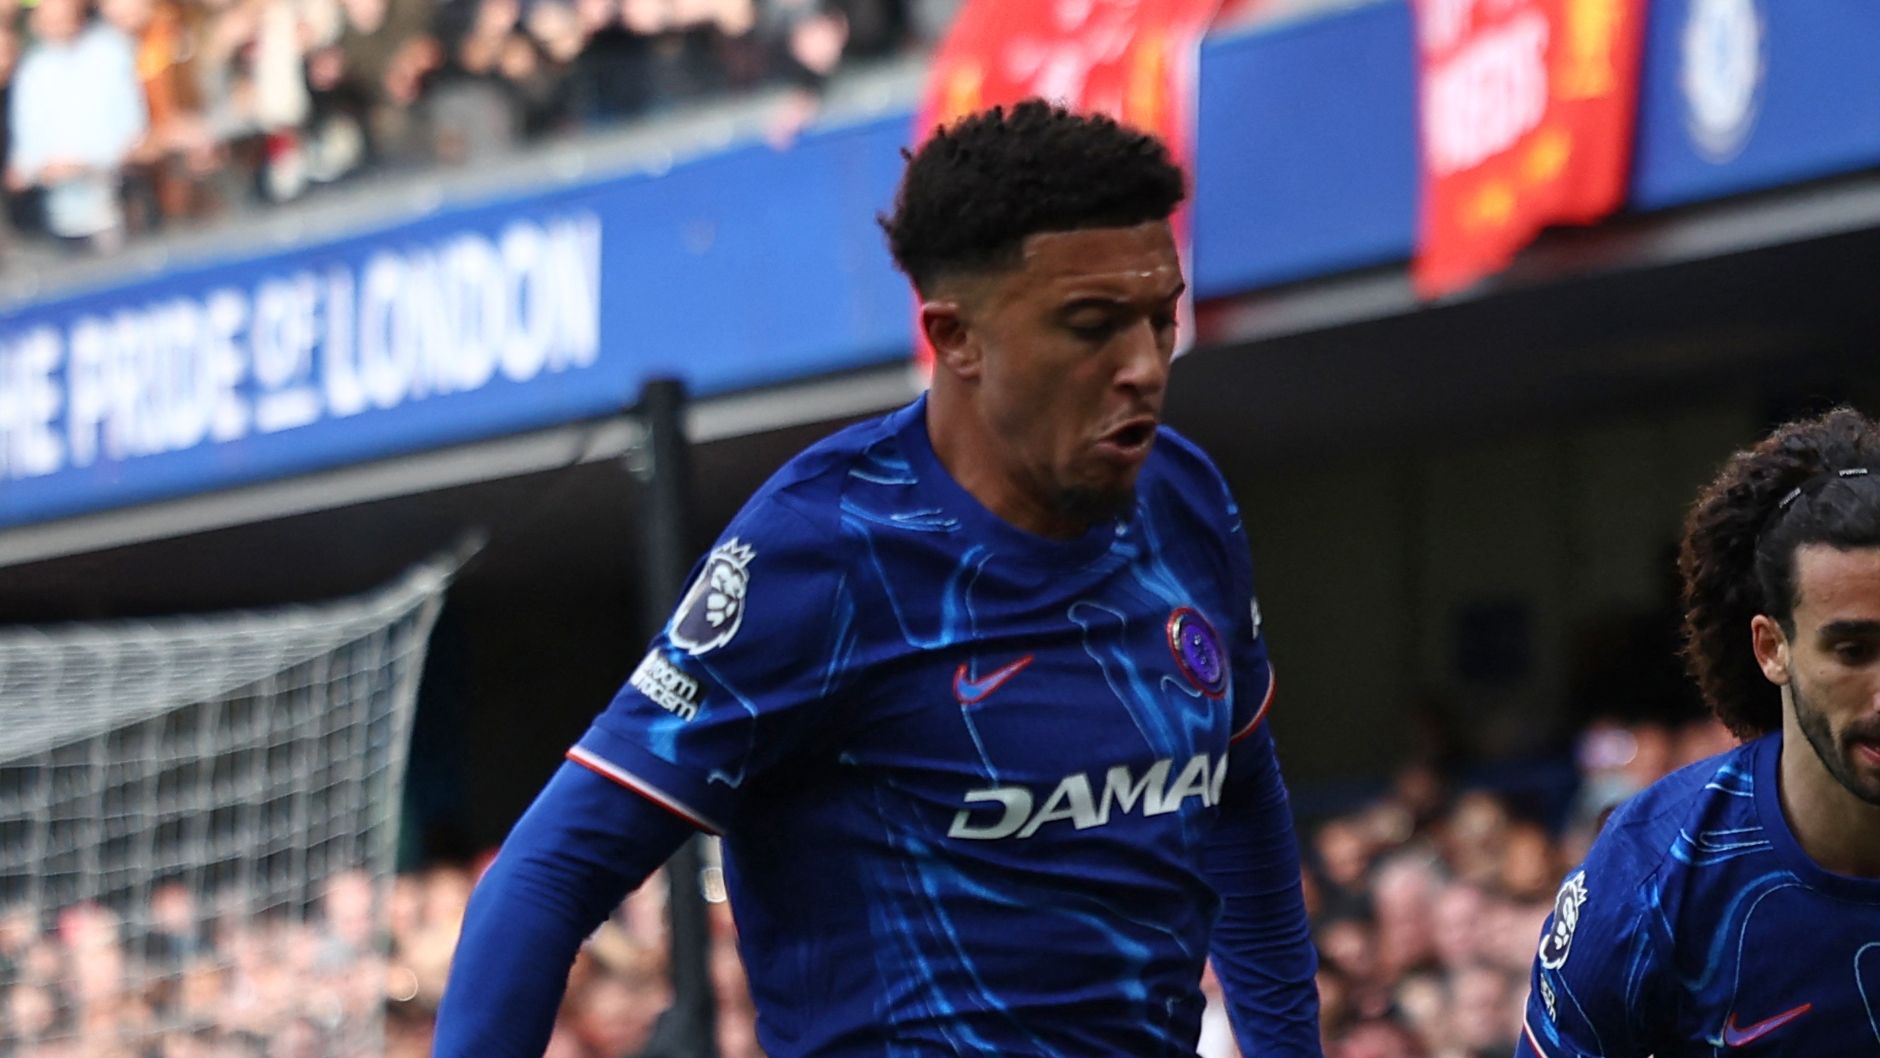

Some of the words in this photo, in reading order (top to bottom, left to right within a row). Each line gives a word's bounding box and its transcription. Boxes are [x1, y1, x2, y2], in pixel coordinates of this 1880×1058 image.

[0, 325, 62, 478] HE
[68, 287, 249, 468] PRIDE
[252, 270, 320, 390] OF
[324, 208, 601, 418] LONDON
